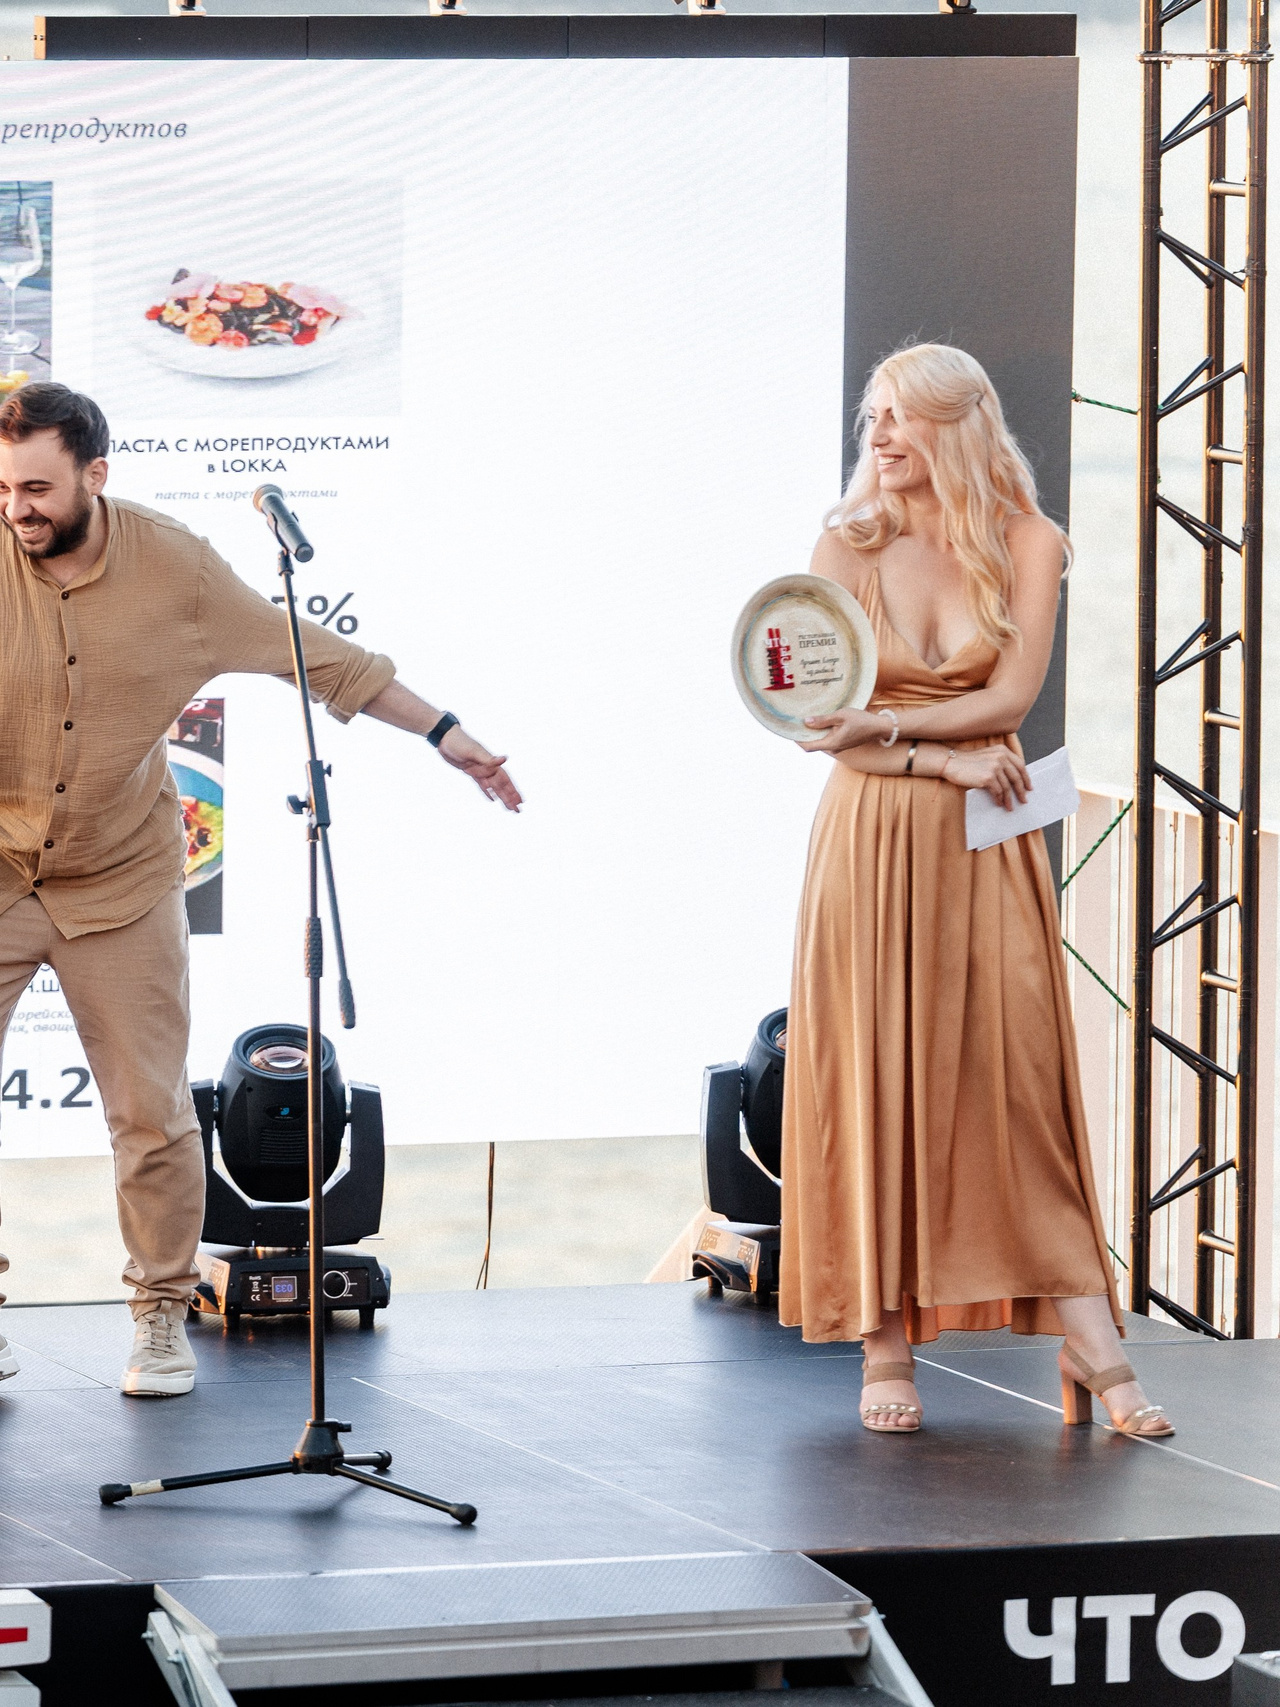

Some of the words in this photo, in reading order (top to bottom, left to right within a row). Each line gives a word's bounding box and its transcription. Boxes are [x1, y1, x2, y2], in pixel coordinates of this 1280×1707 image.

[175, 437, 188, 453] С
[194, 435, 390, 454] МОРЕПРОДУКТАМИ
[207, 463, 216, 473] в
[222, 458, 288, 473] LOKKA
[155, 492, 200, 501] паста
[799, 638, 837, 649] ПРЕМИЯ
[1003, 1590, 1247, 1686] ЧТО
